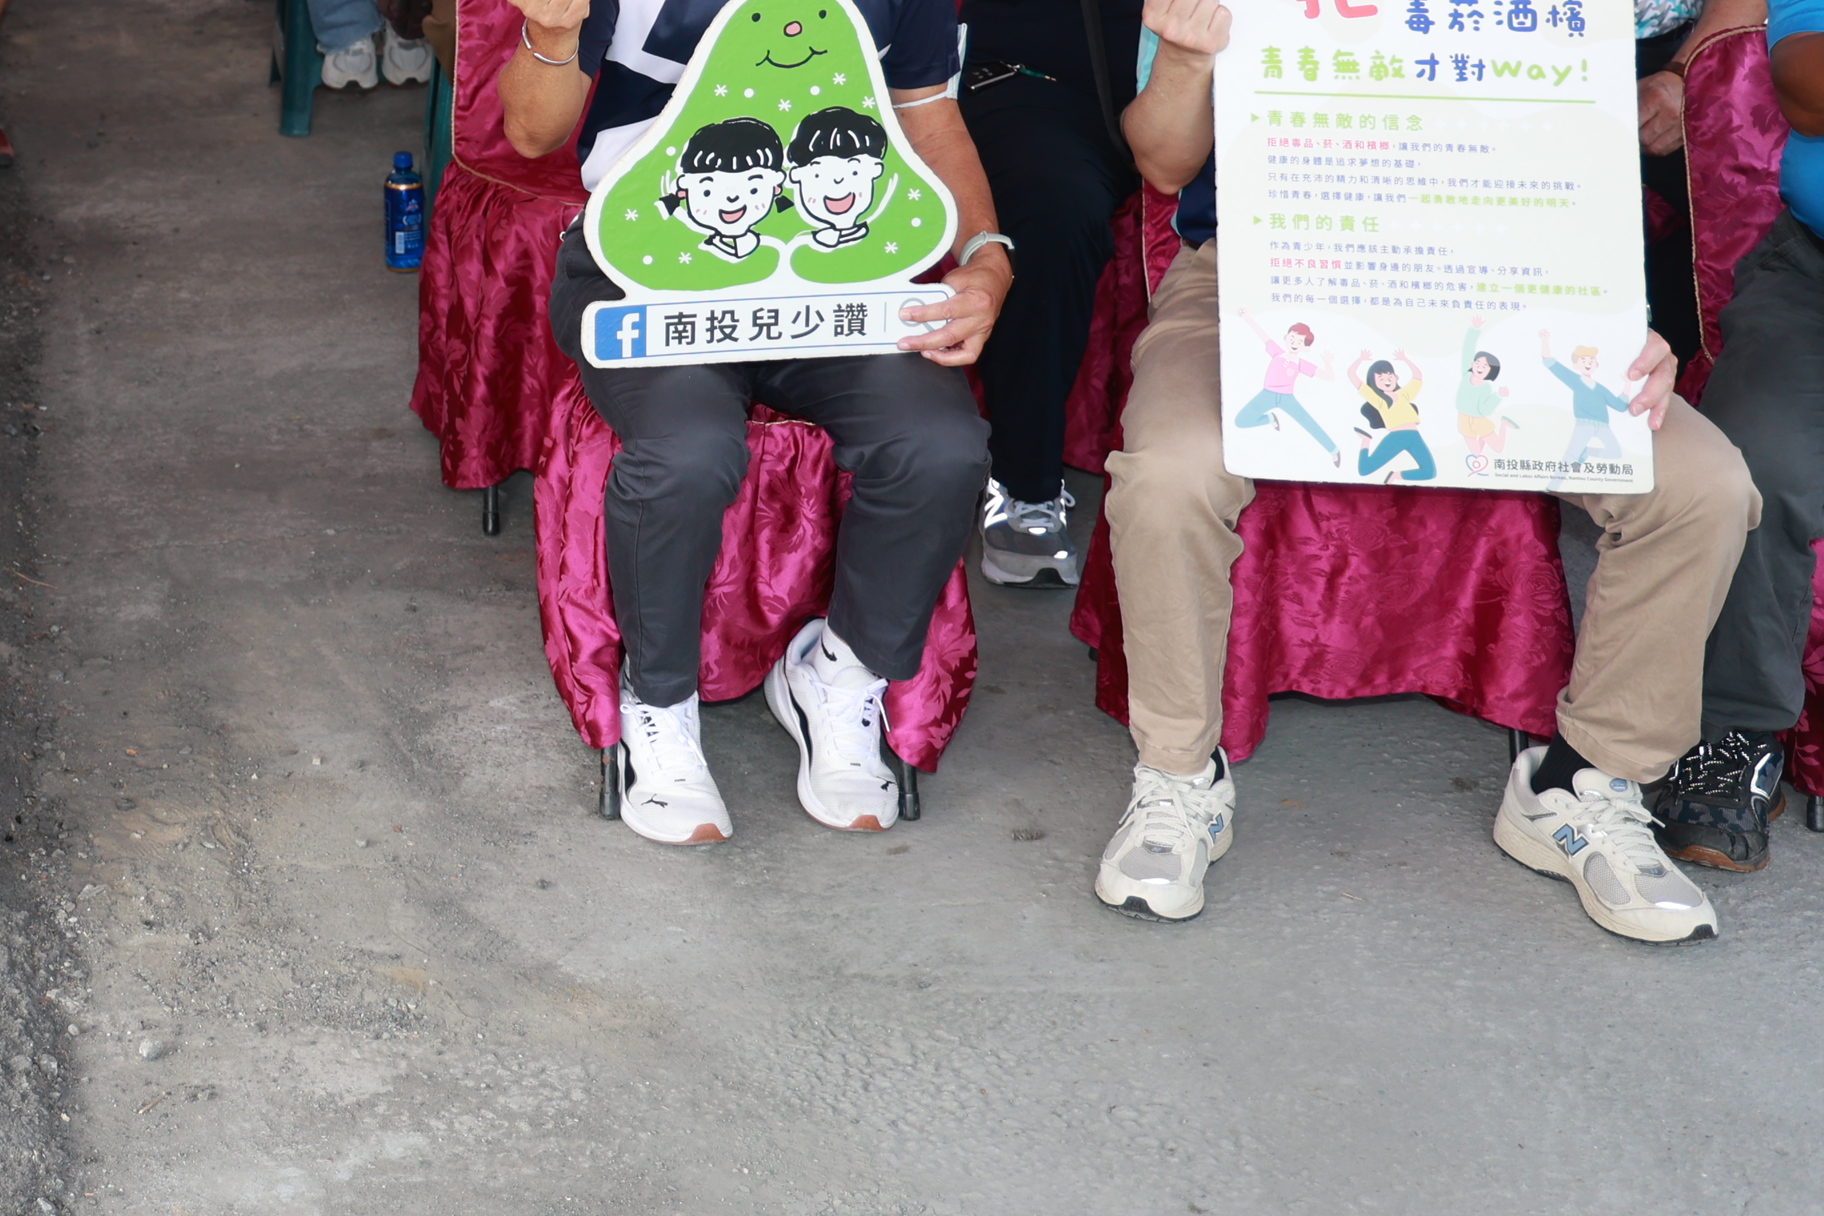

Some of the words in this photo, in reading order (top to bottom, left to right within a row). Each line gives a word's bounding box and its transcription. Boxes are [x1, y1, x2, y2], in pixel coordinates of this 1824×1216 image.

[1266, 110, 1423, 133] 青春無敵的信念
[1269, 212, 1381, 234] 我們的責任
[1493, 459, 1634, 476] 南投縣政府社會及勞動局
